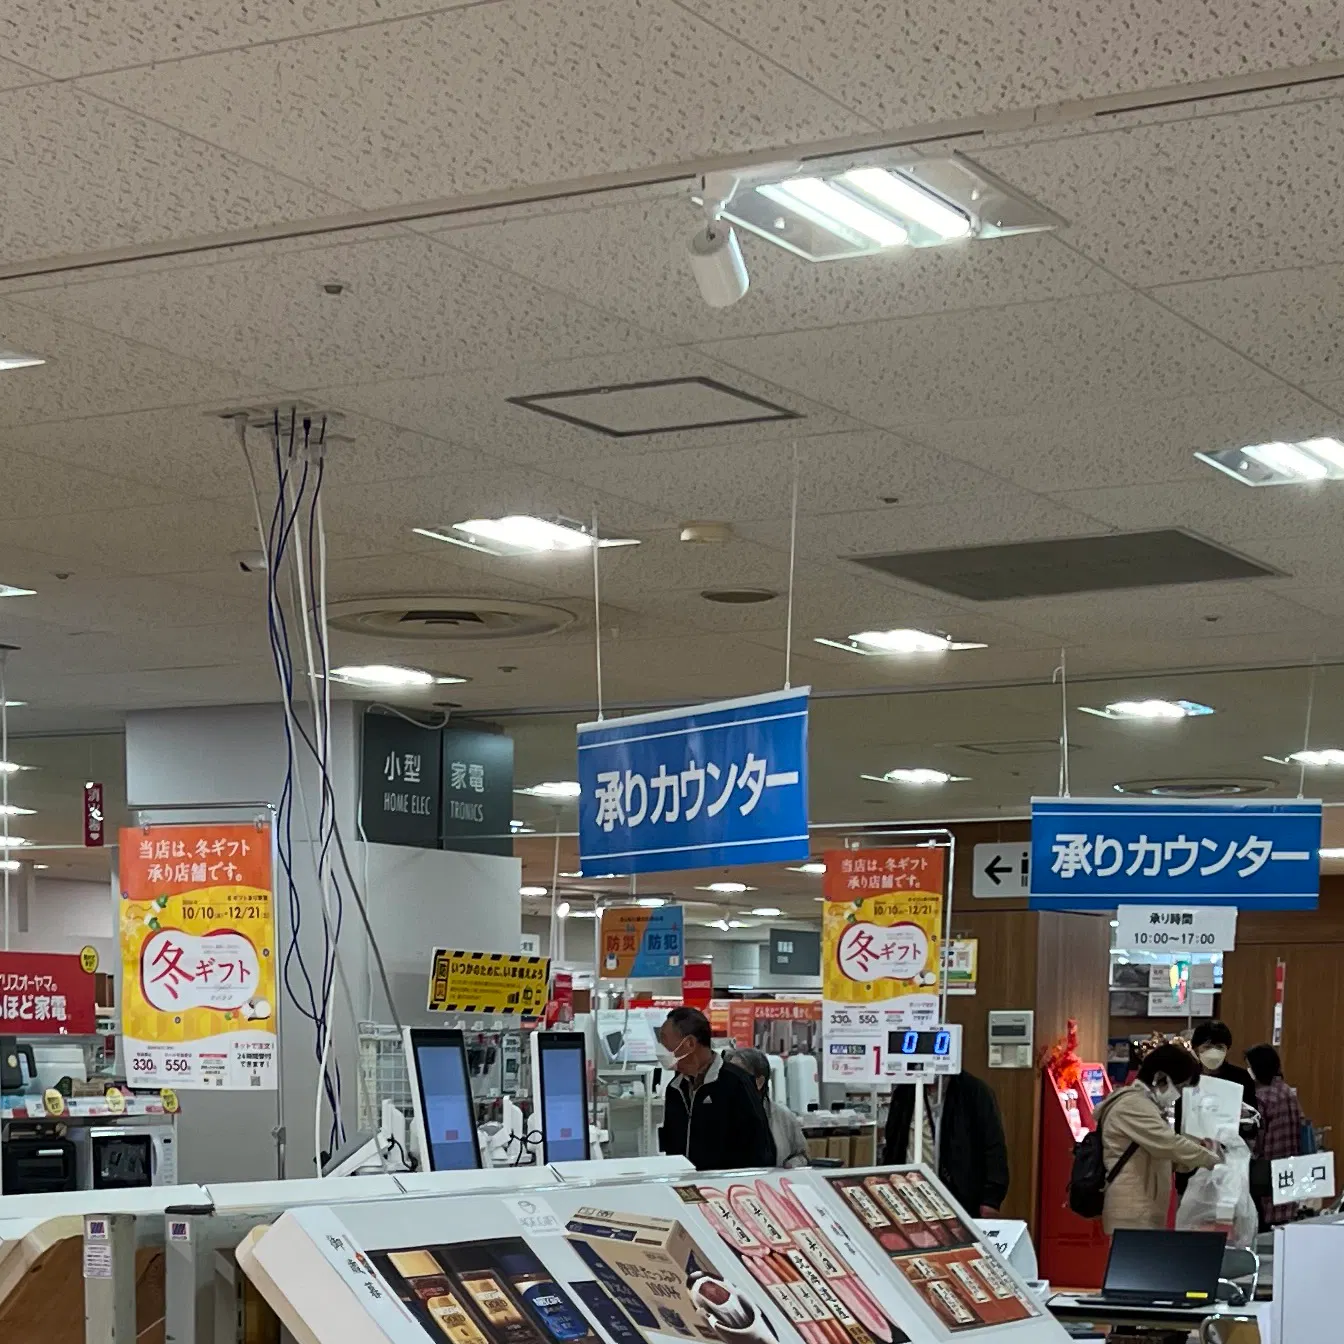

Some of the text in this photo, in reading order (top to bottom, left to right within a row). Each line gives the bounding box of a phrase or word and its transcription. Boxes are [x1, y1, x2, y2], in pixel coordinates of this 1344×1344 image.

[384, 752, 420, 783] 小型
[451, 761, 485, 793] 家電
[384, 793, 431, 816] HOME ELEC
[595, 753, 798, 833] 承りカウンター
[450, 800, 484, 823] TRONICS
[139, 838, 250, 860] 当店は、冬ギフト
[1050, 833, 1310, 879] 承りカウンター
[1149, 911, 1194, 926] 承り時間
[845, 929, 922, 973] 冬ギフト
[150, 939, 251, 1000] 冬ギフト
[902, 1031, 919, 1054] 0
[934, 1031, 950, 1055] 0
